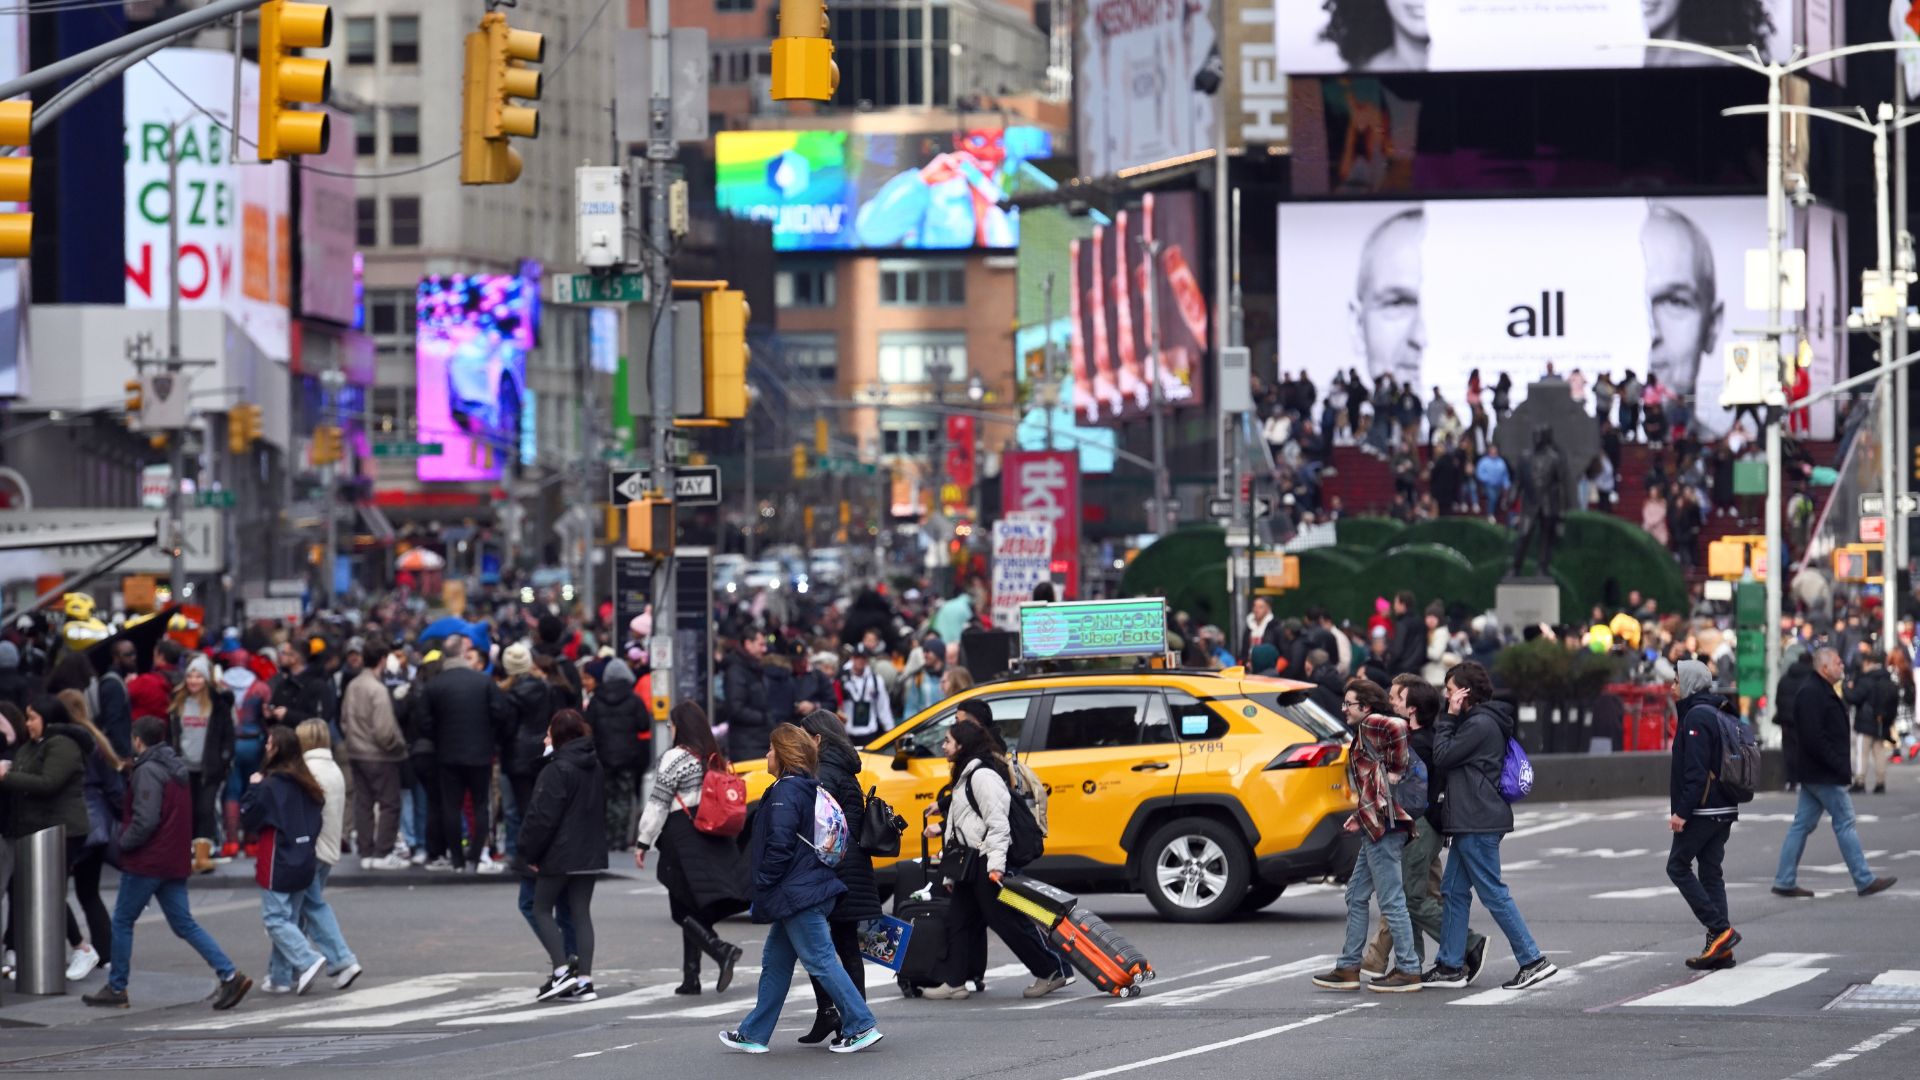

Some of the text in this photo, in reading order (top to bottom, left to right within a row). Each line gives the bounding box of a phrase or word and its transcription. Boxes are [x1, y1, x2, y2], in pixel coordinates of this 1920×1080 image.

[574, 277, 592, 299] W
[601, 278, 623, 299] 45
[1506, 291, 1564, 338] all
[1020, 457, 1067, 520] tkt
[999, 525, 1046, 538] ONLY
[997, 538, 1046, 554] JESUS
[1080, 613, 1129, 630] ONLY
[1131, 611, 1161, 628] ON
[1081, 629, 1161, 645] Uber Eats
[1189, 741, 1224, 754] 5Y89
[914, 792, 934, 801] NYC
